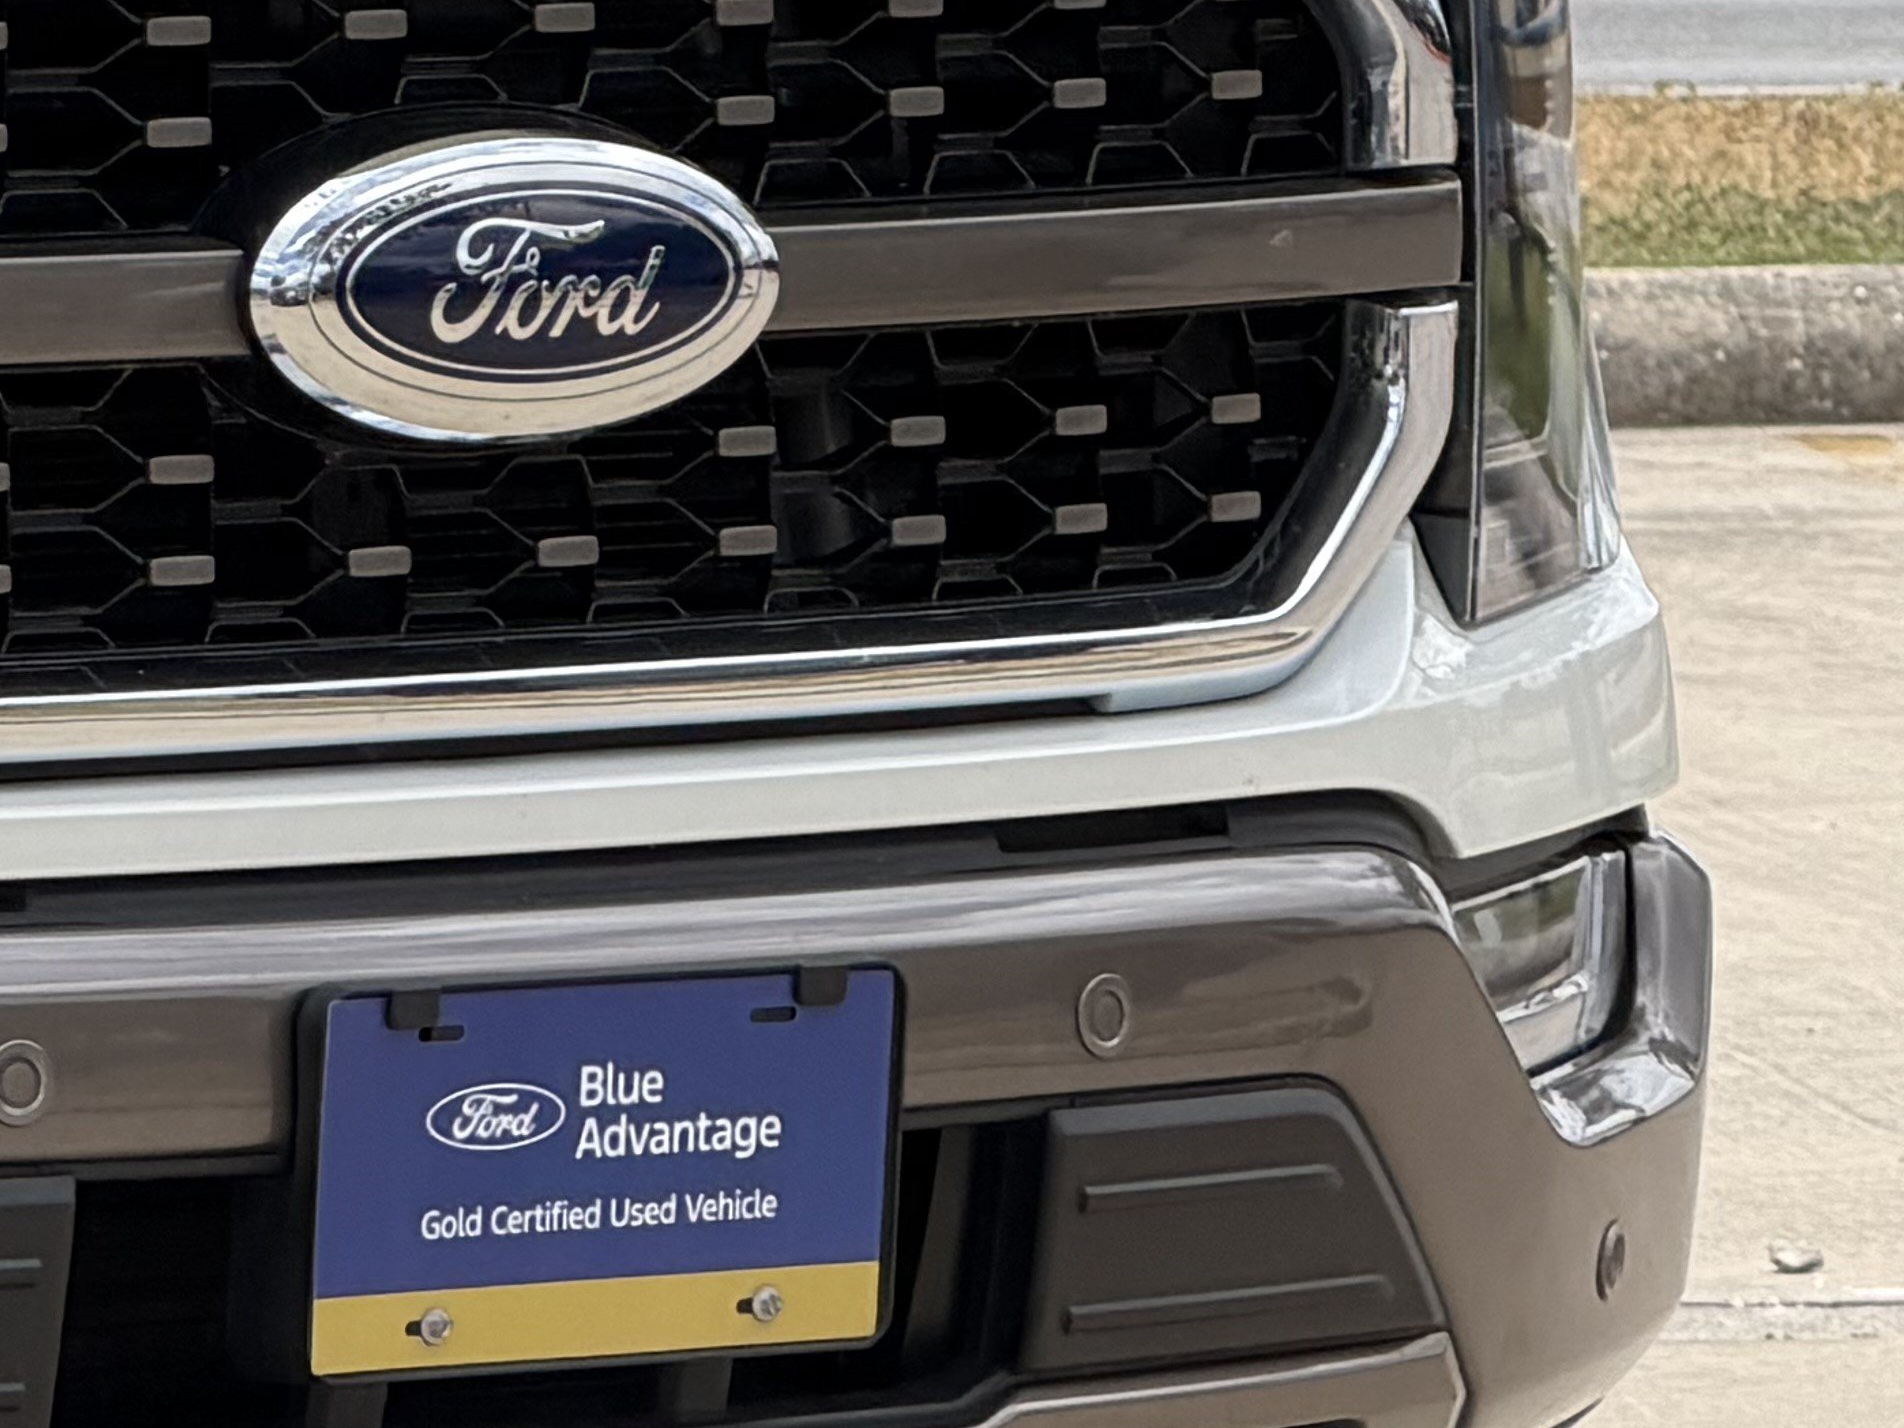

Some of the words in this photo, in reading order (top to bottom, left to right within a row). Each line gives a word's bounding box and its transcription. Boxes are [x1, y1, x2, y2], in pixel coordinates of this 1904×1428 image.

[429, 216, 667, 345] Ford
[578, 1062, 665, 1108] Blue
[450, 1093, 541, 1141] Ford
[575, 1110, 783, 1160] Advantage
[420, 1205, 483, 1241] Gold
[490, 1197, 602, 1237] Certified
[609, 1192, 678, 1229] Used
[685, 1187, 779, 1225] Vehicle
